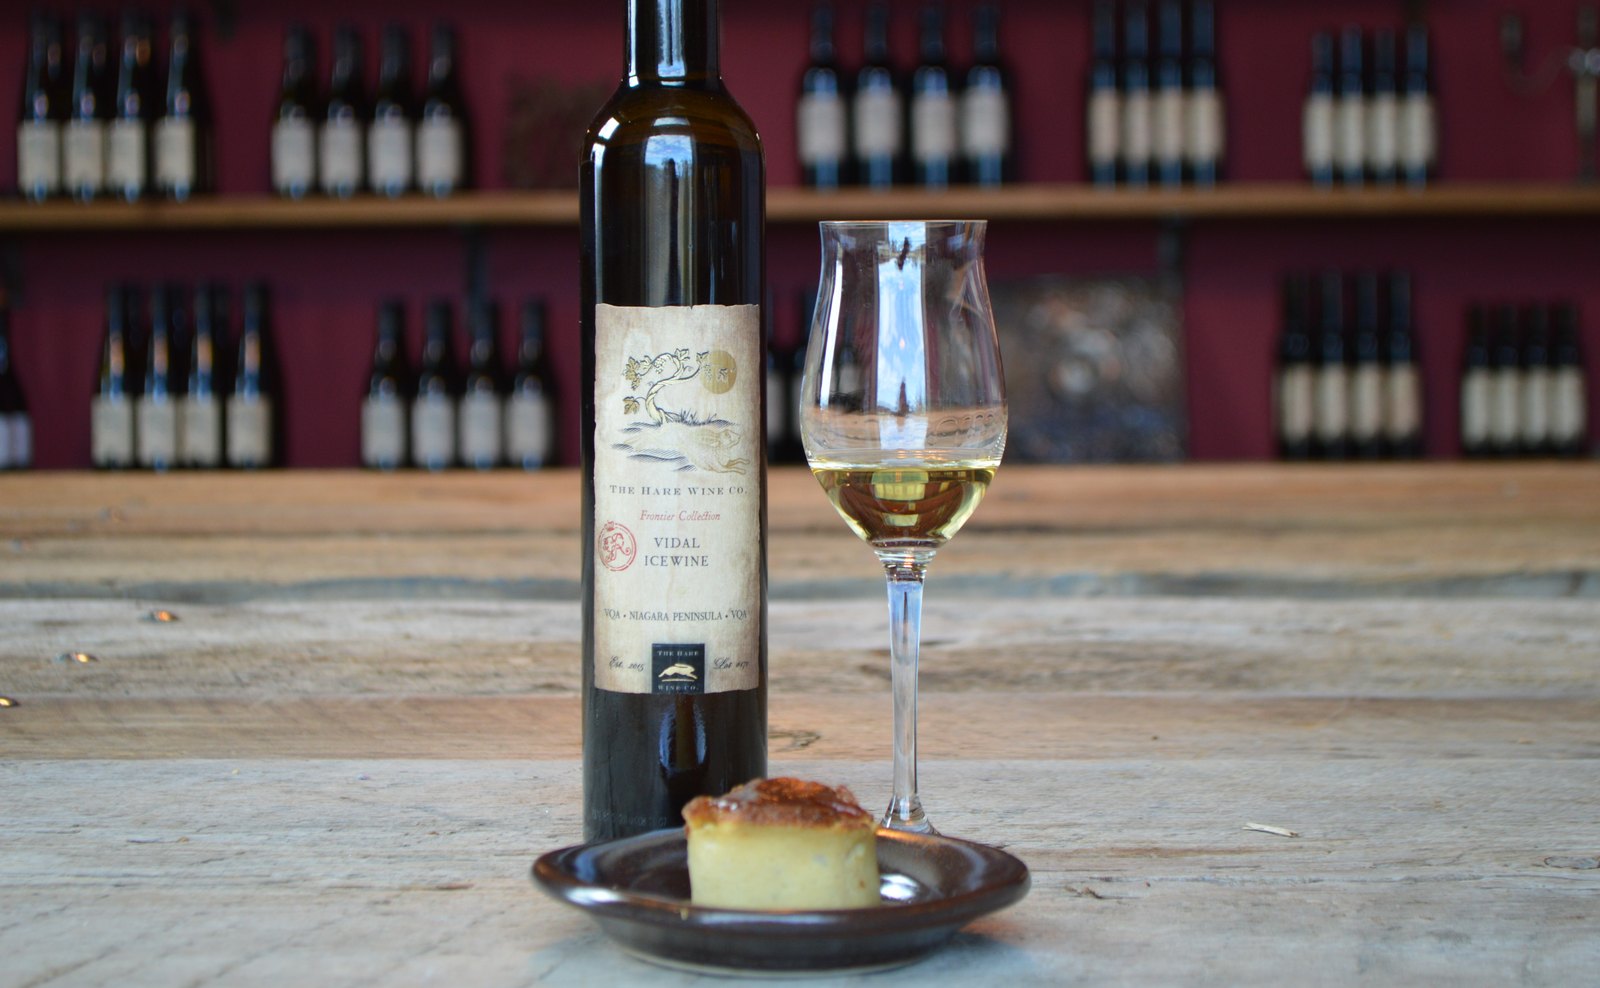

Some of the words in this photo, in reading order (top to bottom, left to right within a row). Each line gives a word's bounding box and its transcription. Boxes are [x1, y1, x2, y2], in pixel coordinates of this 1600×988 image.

[609, 485, 635, 495] THE
[641, 487, 681, 496] HARE
[688, 487, 724, 496] WINE
[640, 510, 675, 520] Frontier
[679, 510, 720, 521] Collection
[654, 537, 700, 548] VIDAL
[645, 555, 709, 567] ICEWINE
[604, 608, 620, 620] VQA
[629, 611, 669, 621] NIAGARA
[673, 611, 722, 621] PENINSULA
[731, 609, 747, 620] VQA
